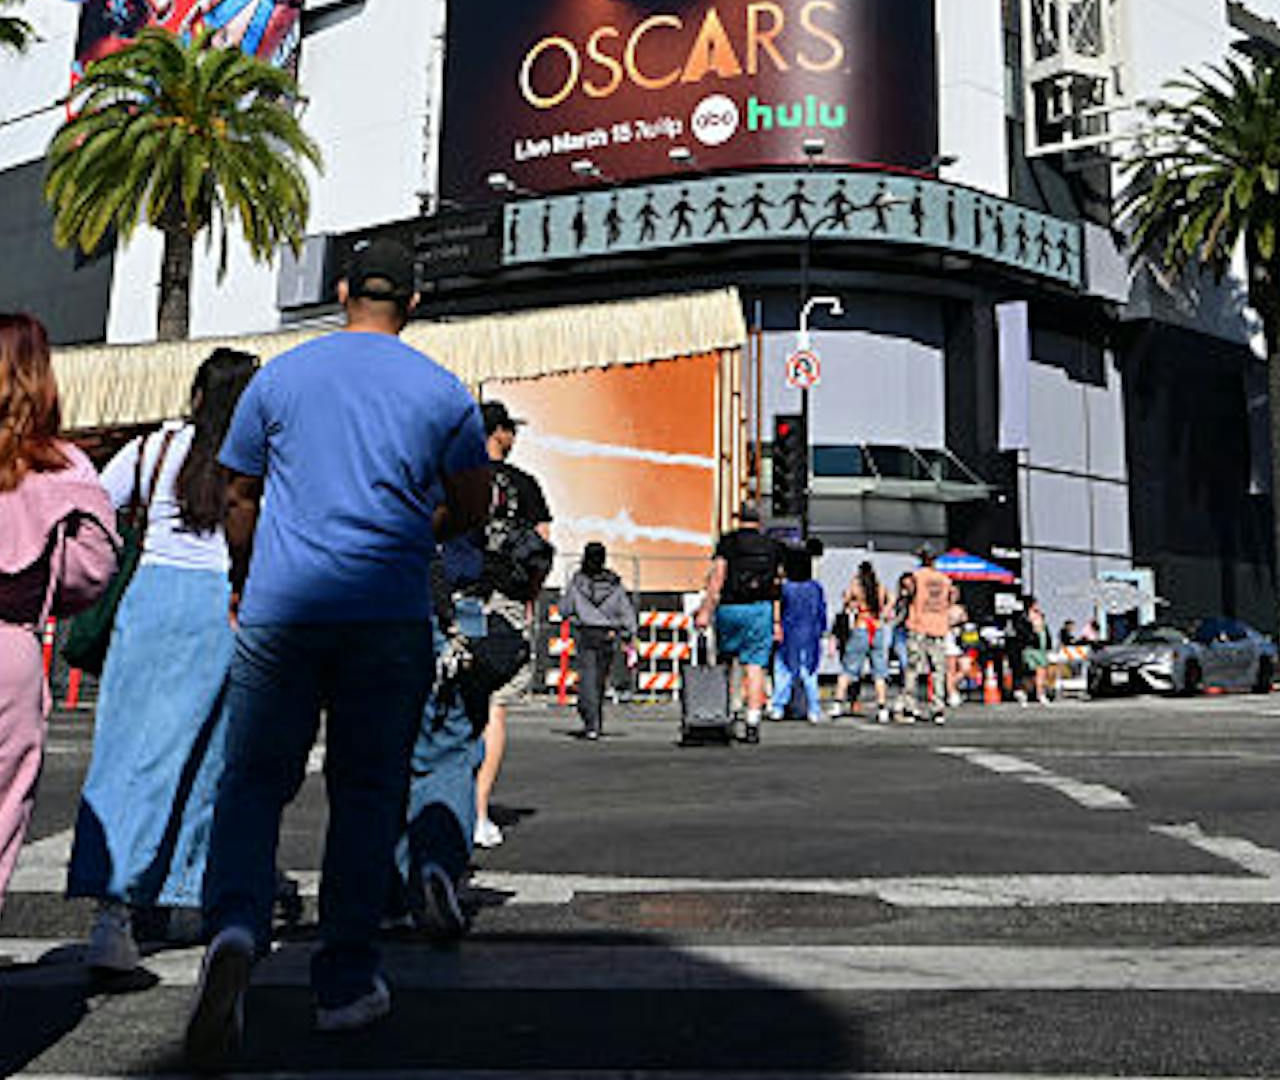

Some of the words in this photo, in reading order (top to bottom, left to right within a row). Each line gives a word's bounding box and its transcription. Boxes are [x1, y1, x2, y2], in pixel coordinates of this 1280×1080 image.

[520, 0, 845, 108] OSCARS
[552, 128, 608, 154] March
[611, 123, 632, 143] 15
[746, 94, 847, 132] hulu
